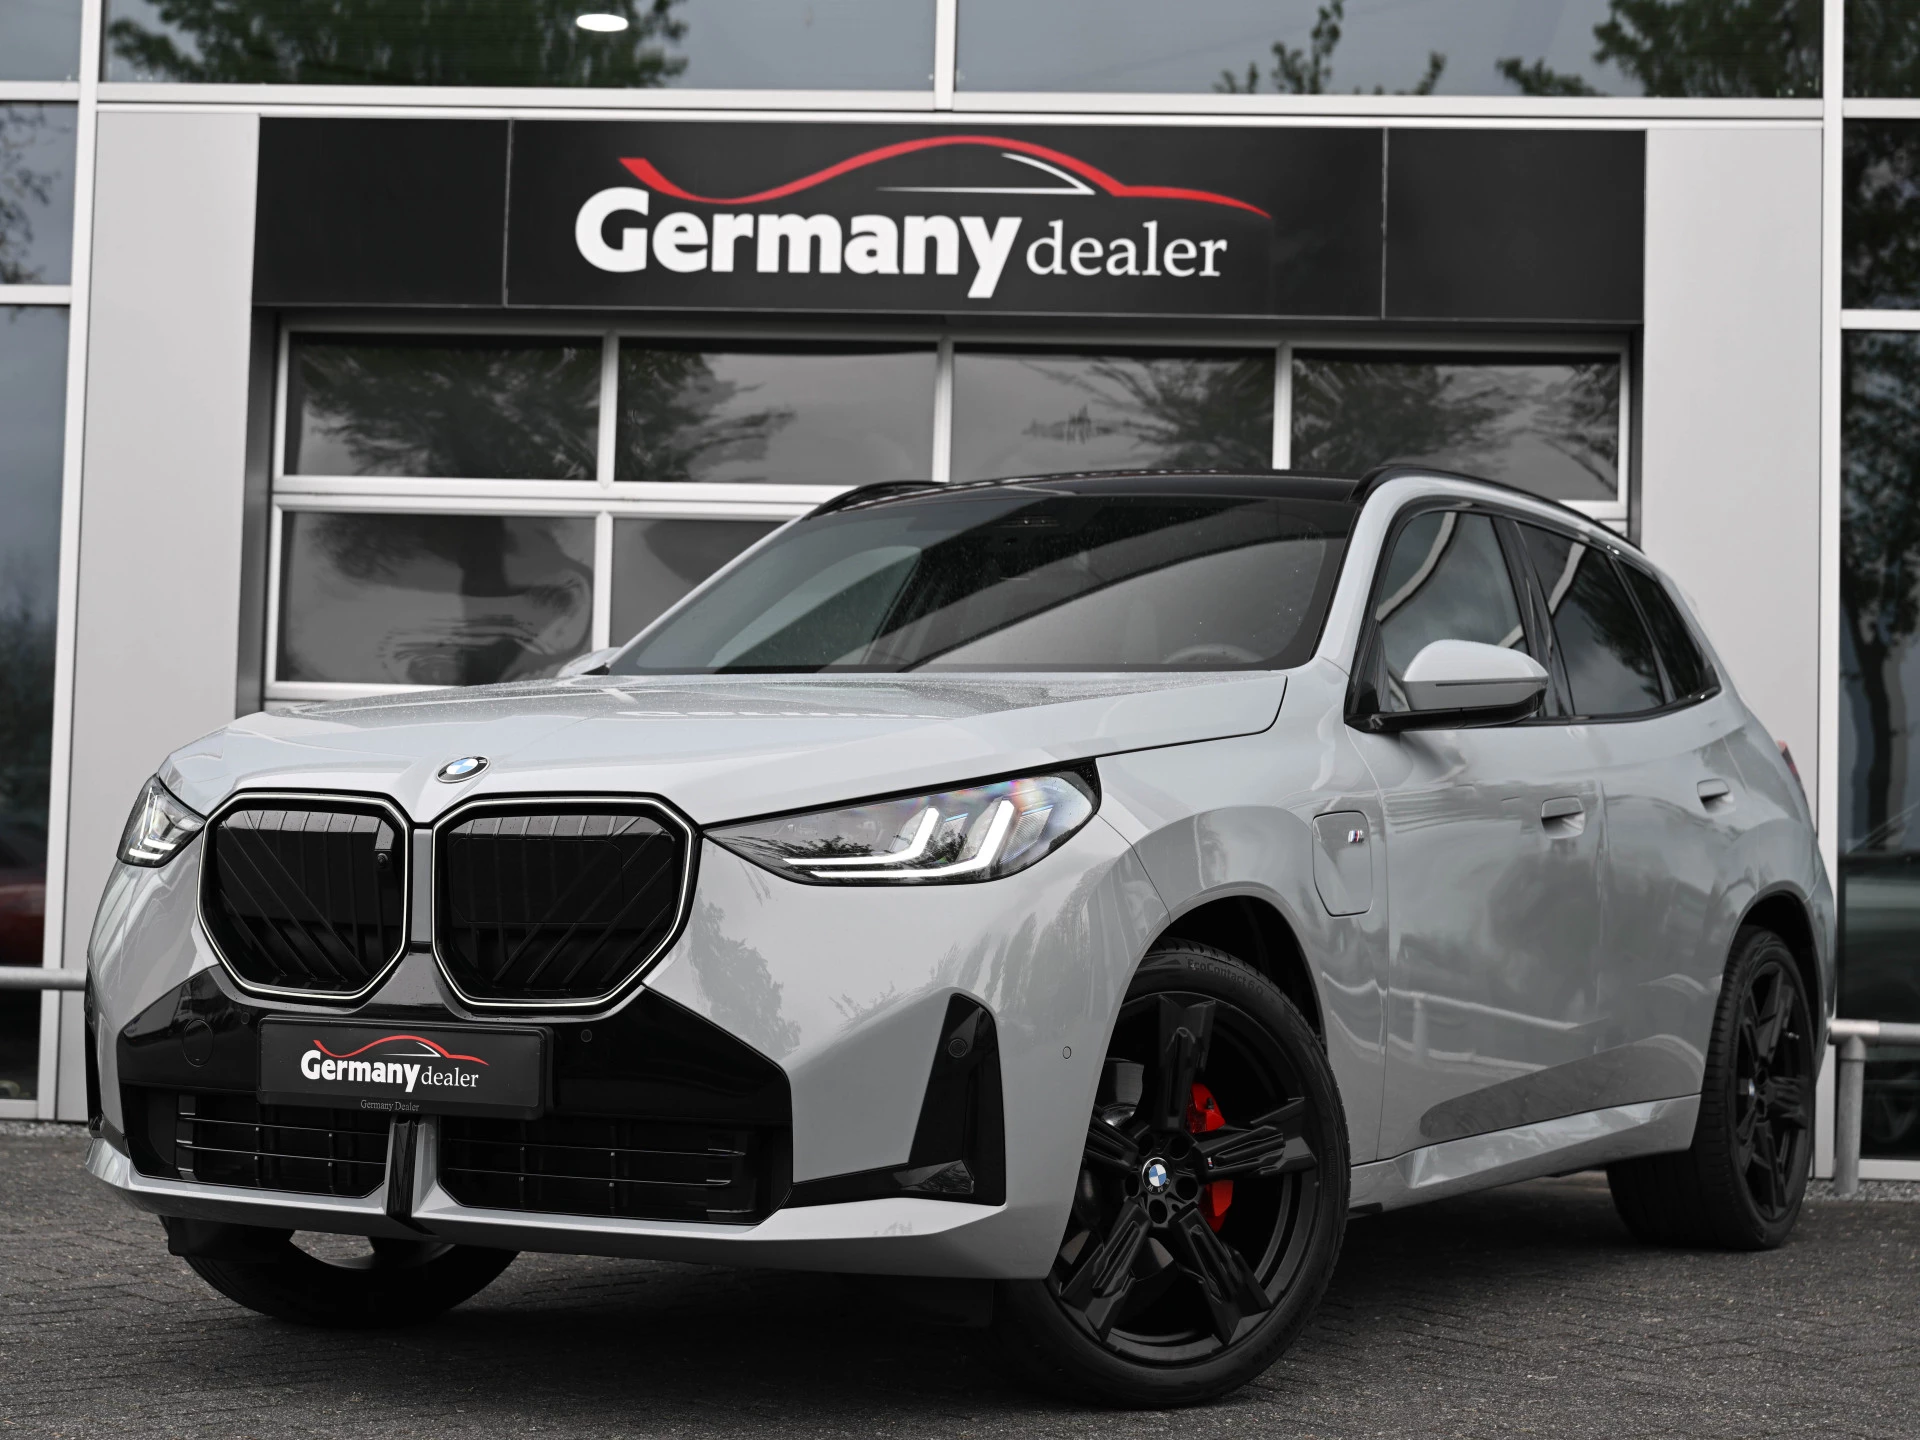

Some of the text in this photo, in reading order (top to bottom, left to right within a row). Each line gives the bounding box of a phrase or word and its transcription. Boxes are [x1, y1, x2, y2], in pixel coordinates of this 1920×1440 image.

[575, 186, 1228, 299] Germany dealer
[300, 1049, 479, 1093] Germany dealer
[360, 1099, 420, 1112] Germany Dealer
